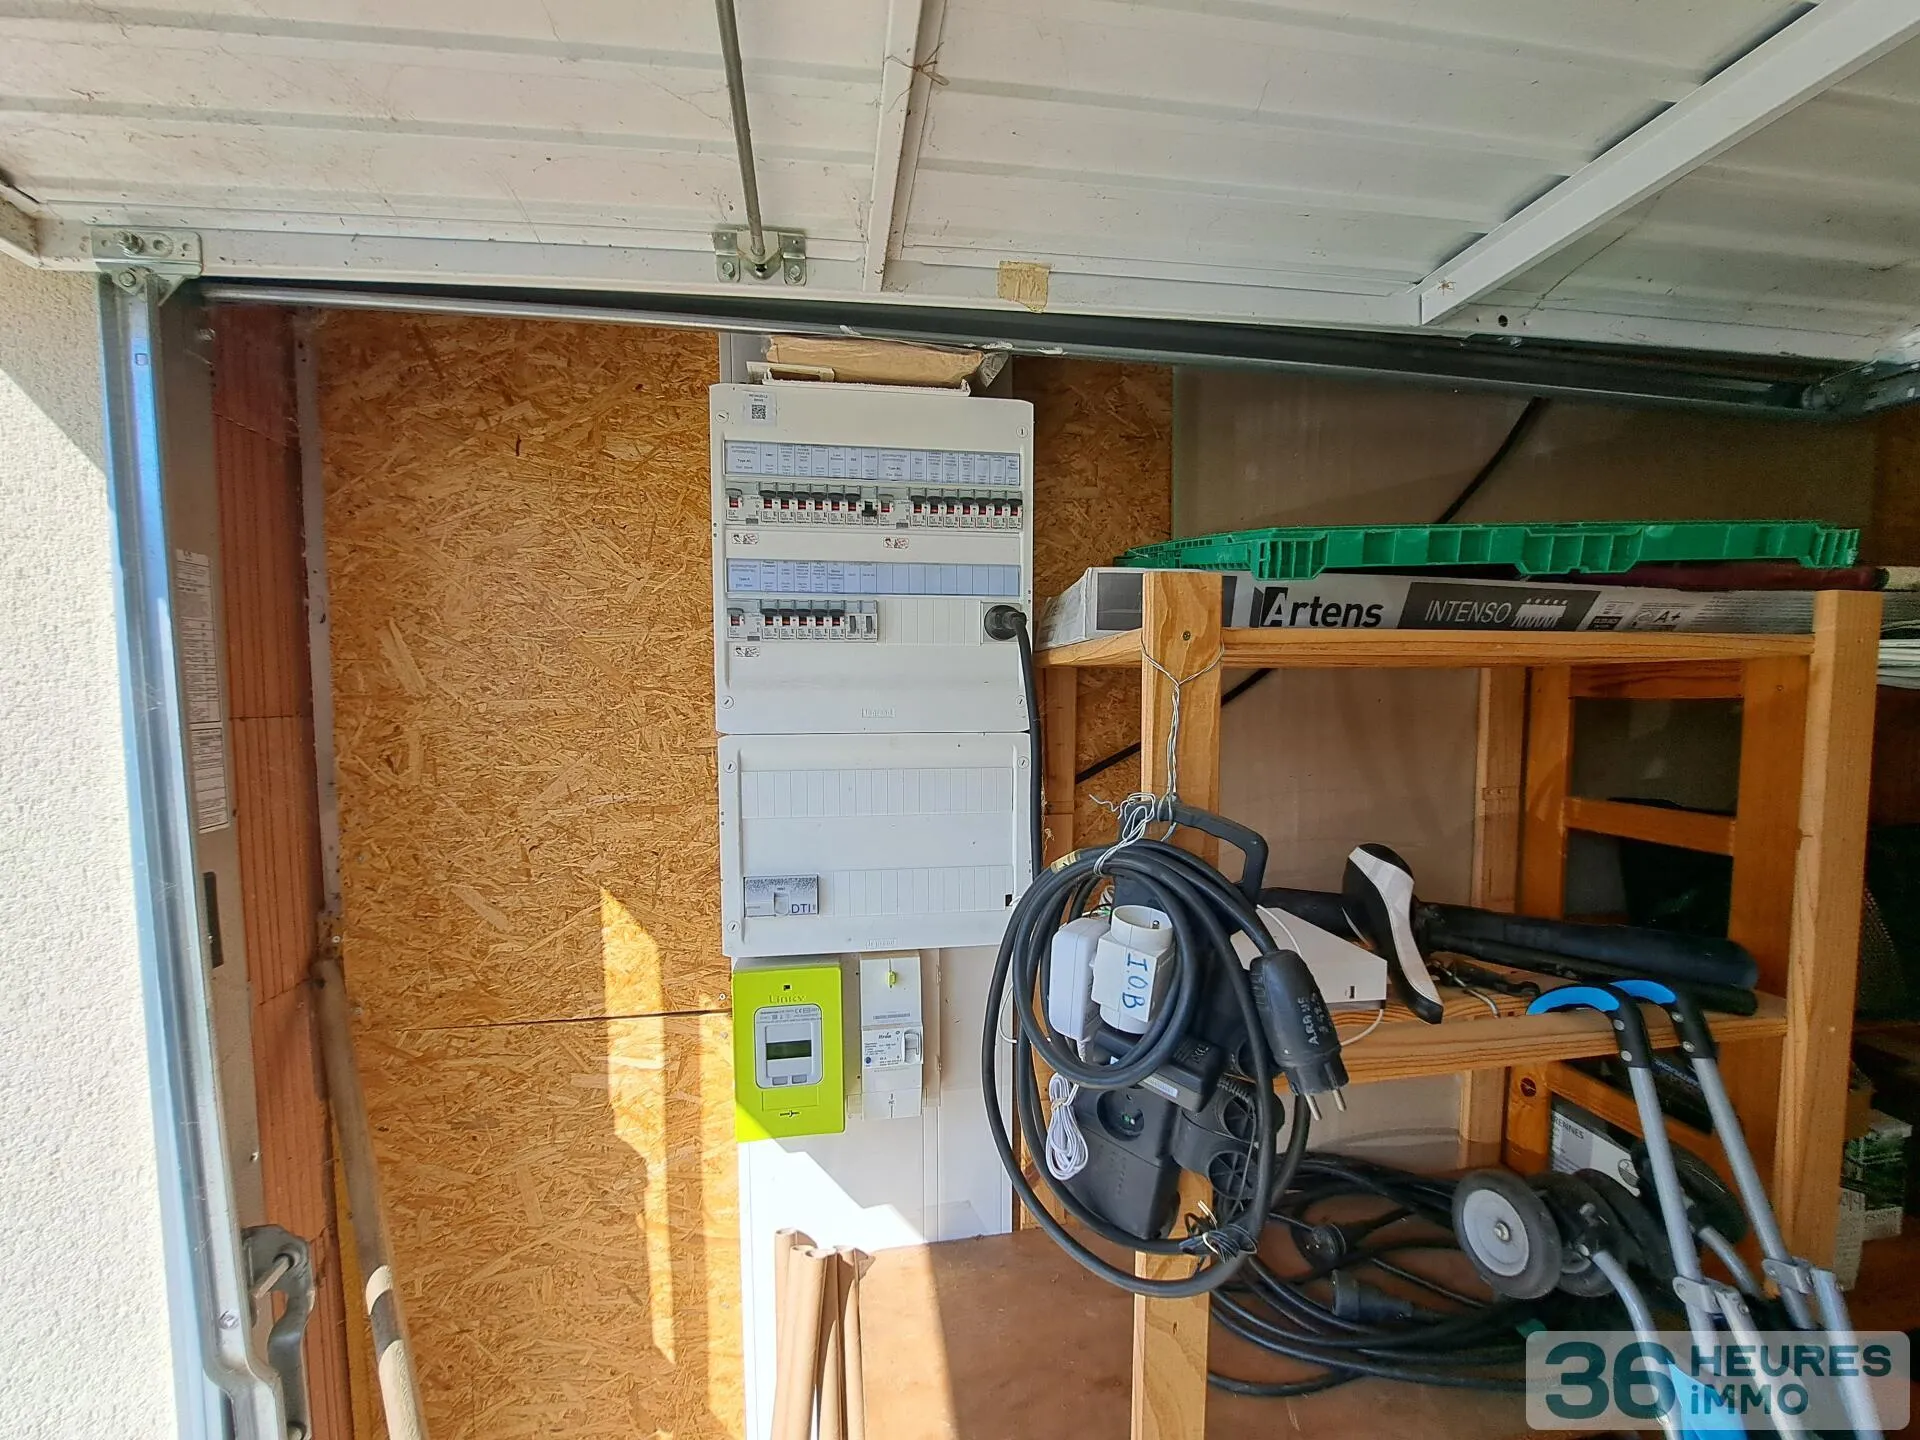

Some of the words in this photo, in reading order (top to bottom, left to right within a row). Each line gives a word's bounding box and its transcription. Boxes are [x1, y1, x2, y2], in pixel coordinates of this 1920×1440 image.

[1262, 588, 1384, 628] Artens
[1423, 599, 1513, 625] INTENSO
[791, 903, 811, 914] DTI
